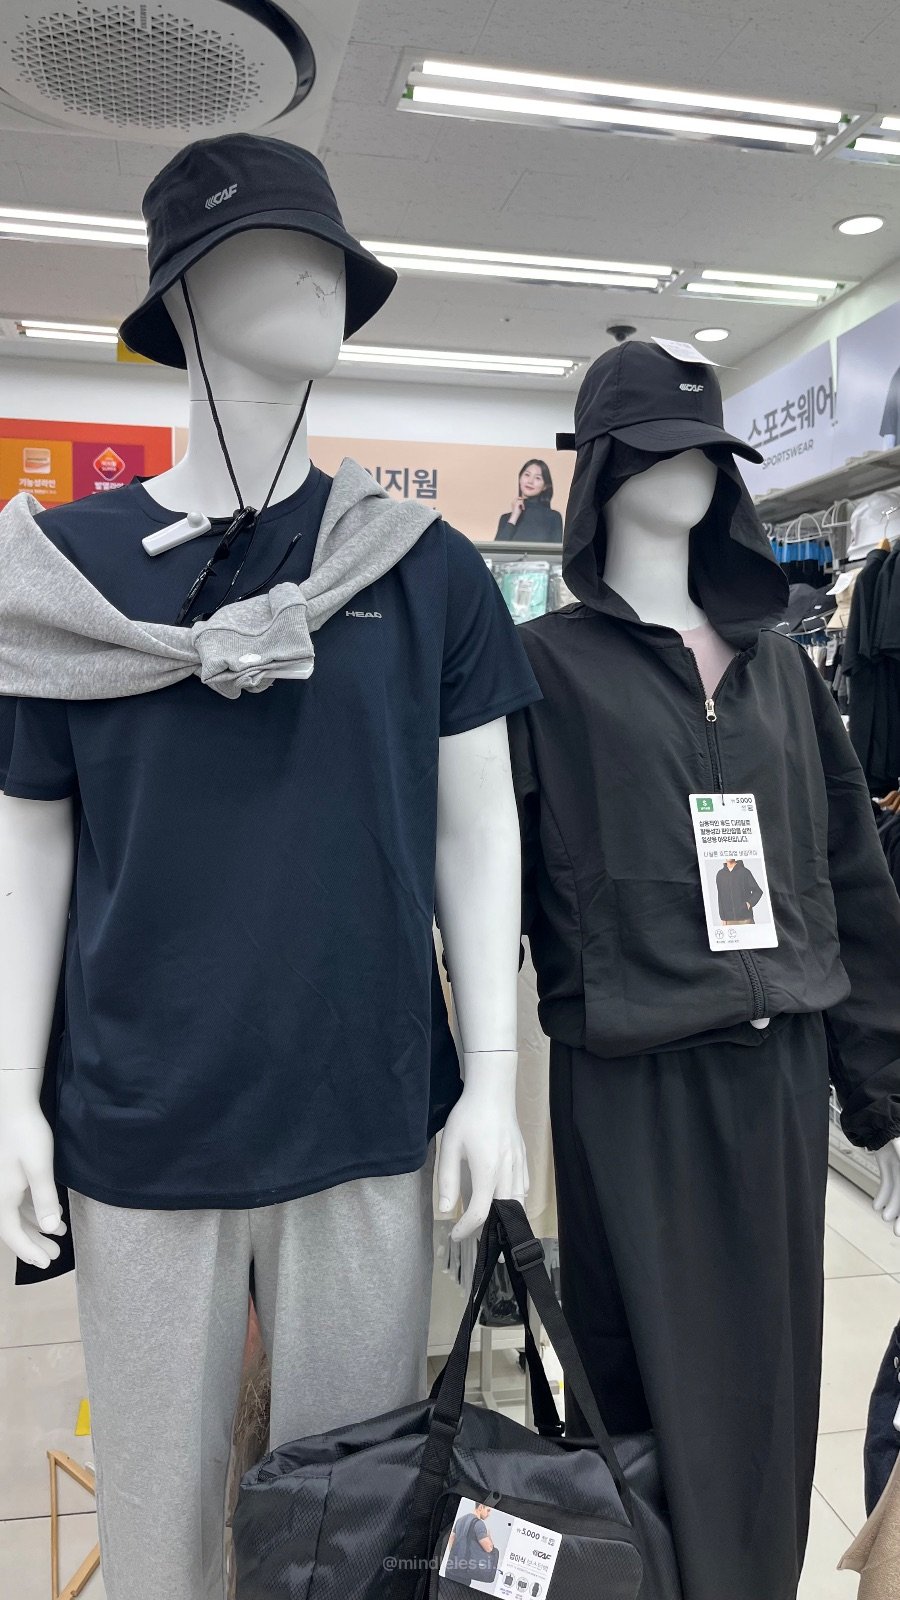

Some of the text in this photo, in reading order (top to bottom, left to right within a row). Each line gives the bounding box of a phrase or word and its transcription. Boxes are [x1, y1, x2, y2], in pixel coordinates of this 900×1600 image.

[748, 376, 835, 449] 스포츠웨어
[762, 439, 814, 470] SPORTSWEAR
[18, 477, 56, 489] 기능성라인
[345, 610, 383, 619] HEAD
